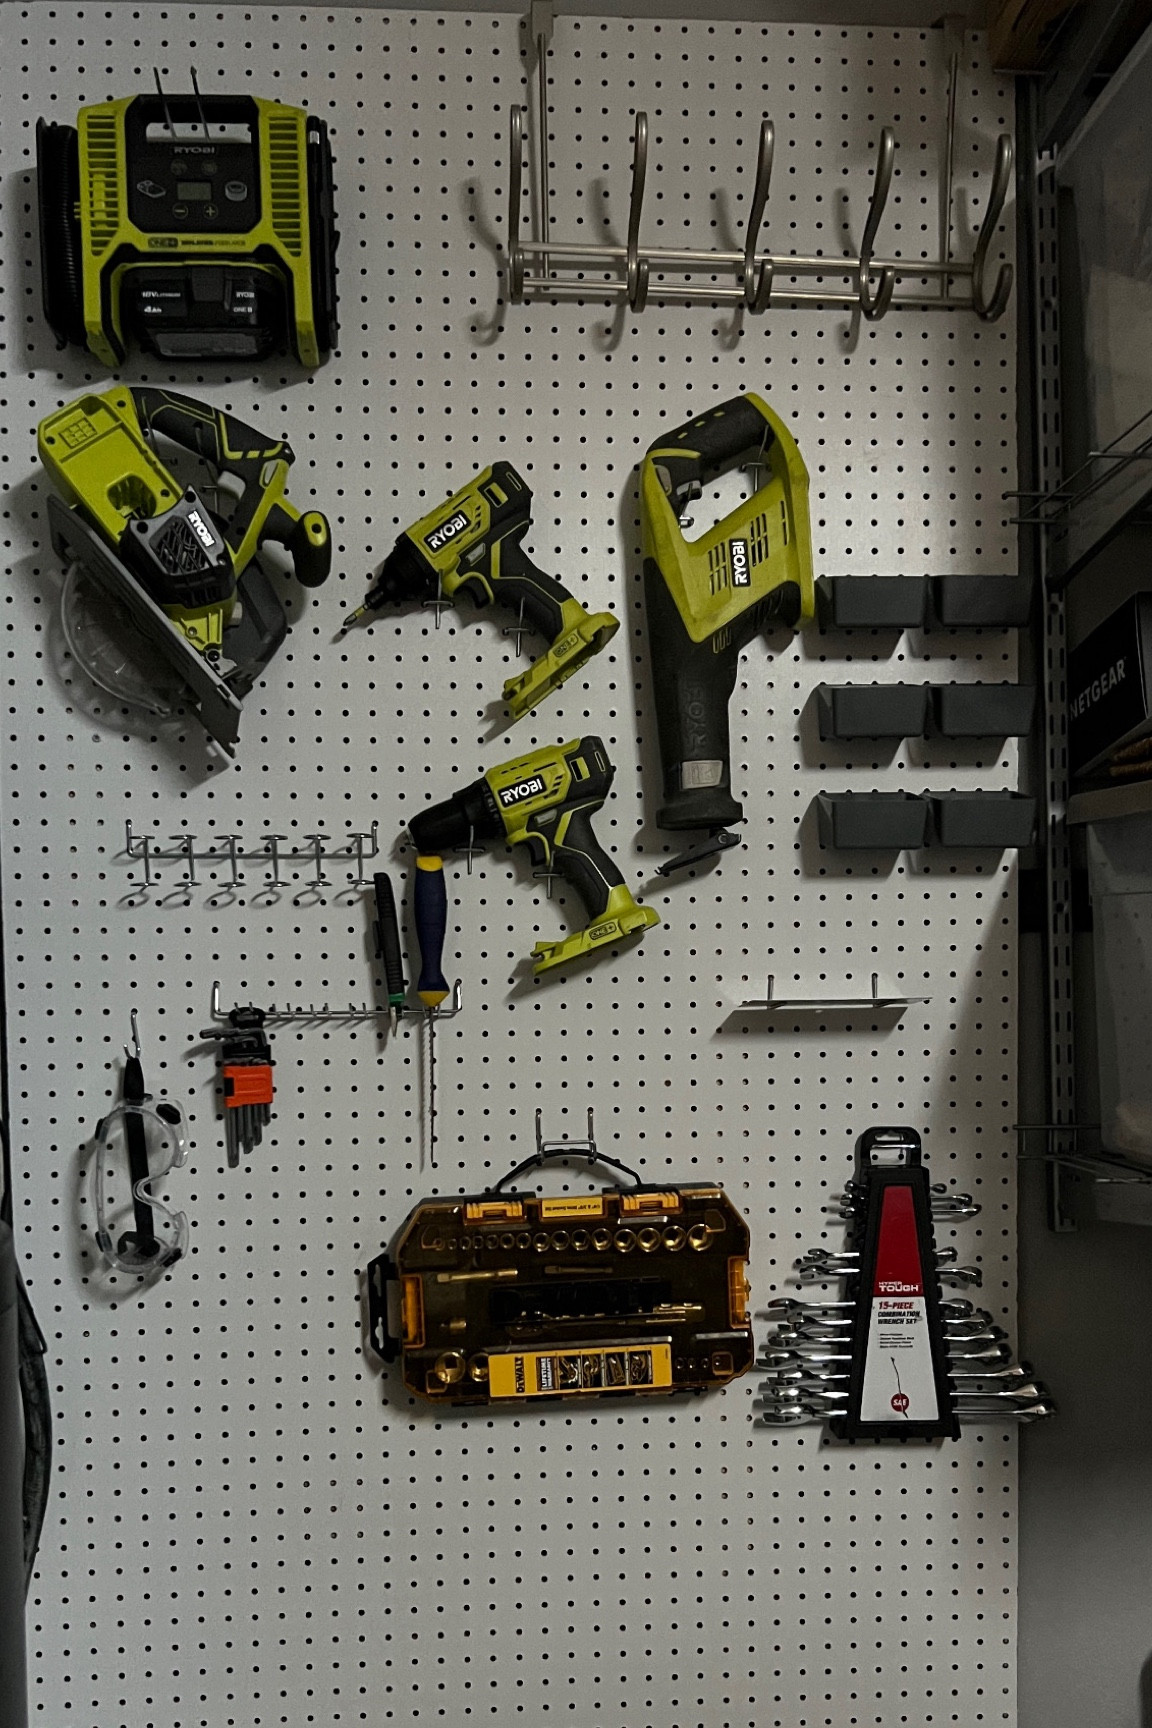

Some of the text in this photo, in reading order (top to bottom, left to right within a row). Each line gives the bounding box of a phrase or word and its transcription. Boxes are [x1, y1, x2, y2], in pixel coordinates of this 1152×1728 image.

[173, 146, 215, 154] RYOBI
[188, 510, 216, 547] RYOBI
[427, 514, 467, 550] RYOBI
[733, 540, 749, 586] RYOBI
[1069, 657, 1126, 721] NETGEAR
[500, 778, 543, 804] RYOBI
[878, 1284, 919, 1292] TOUGH
[879, 1301, 914, 1310] 15-PIECE
